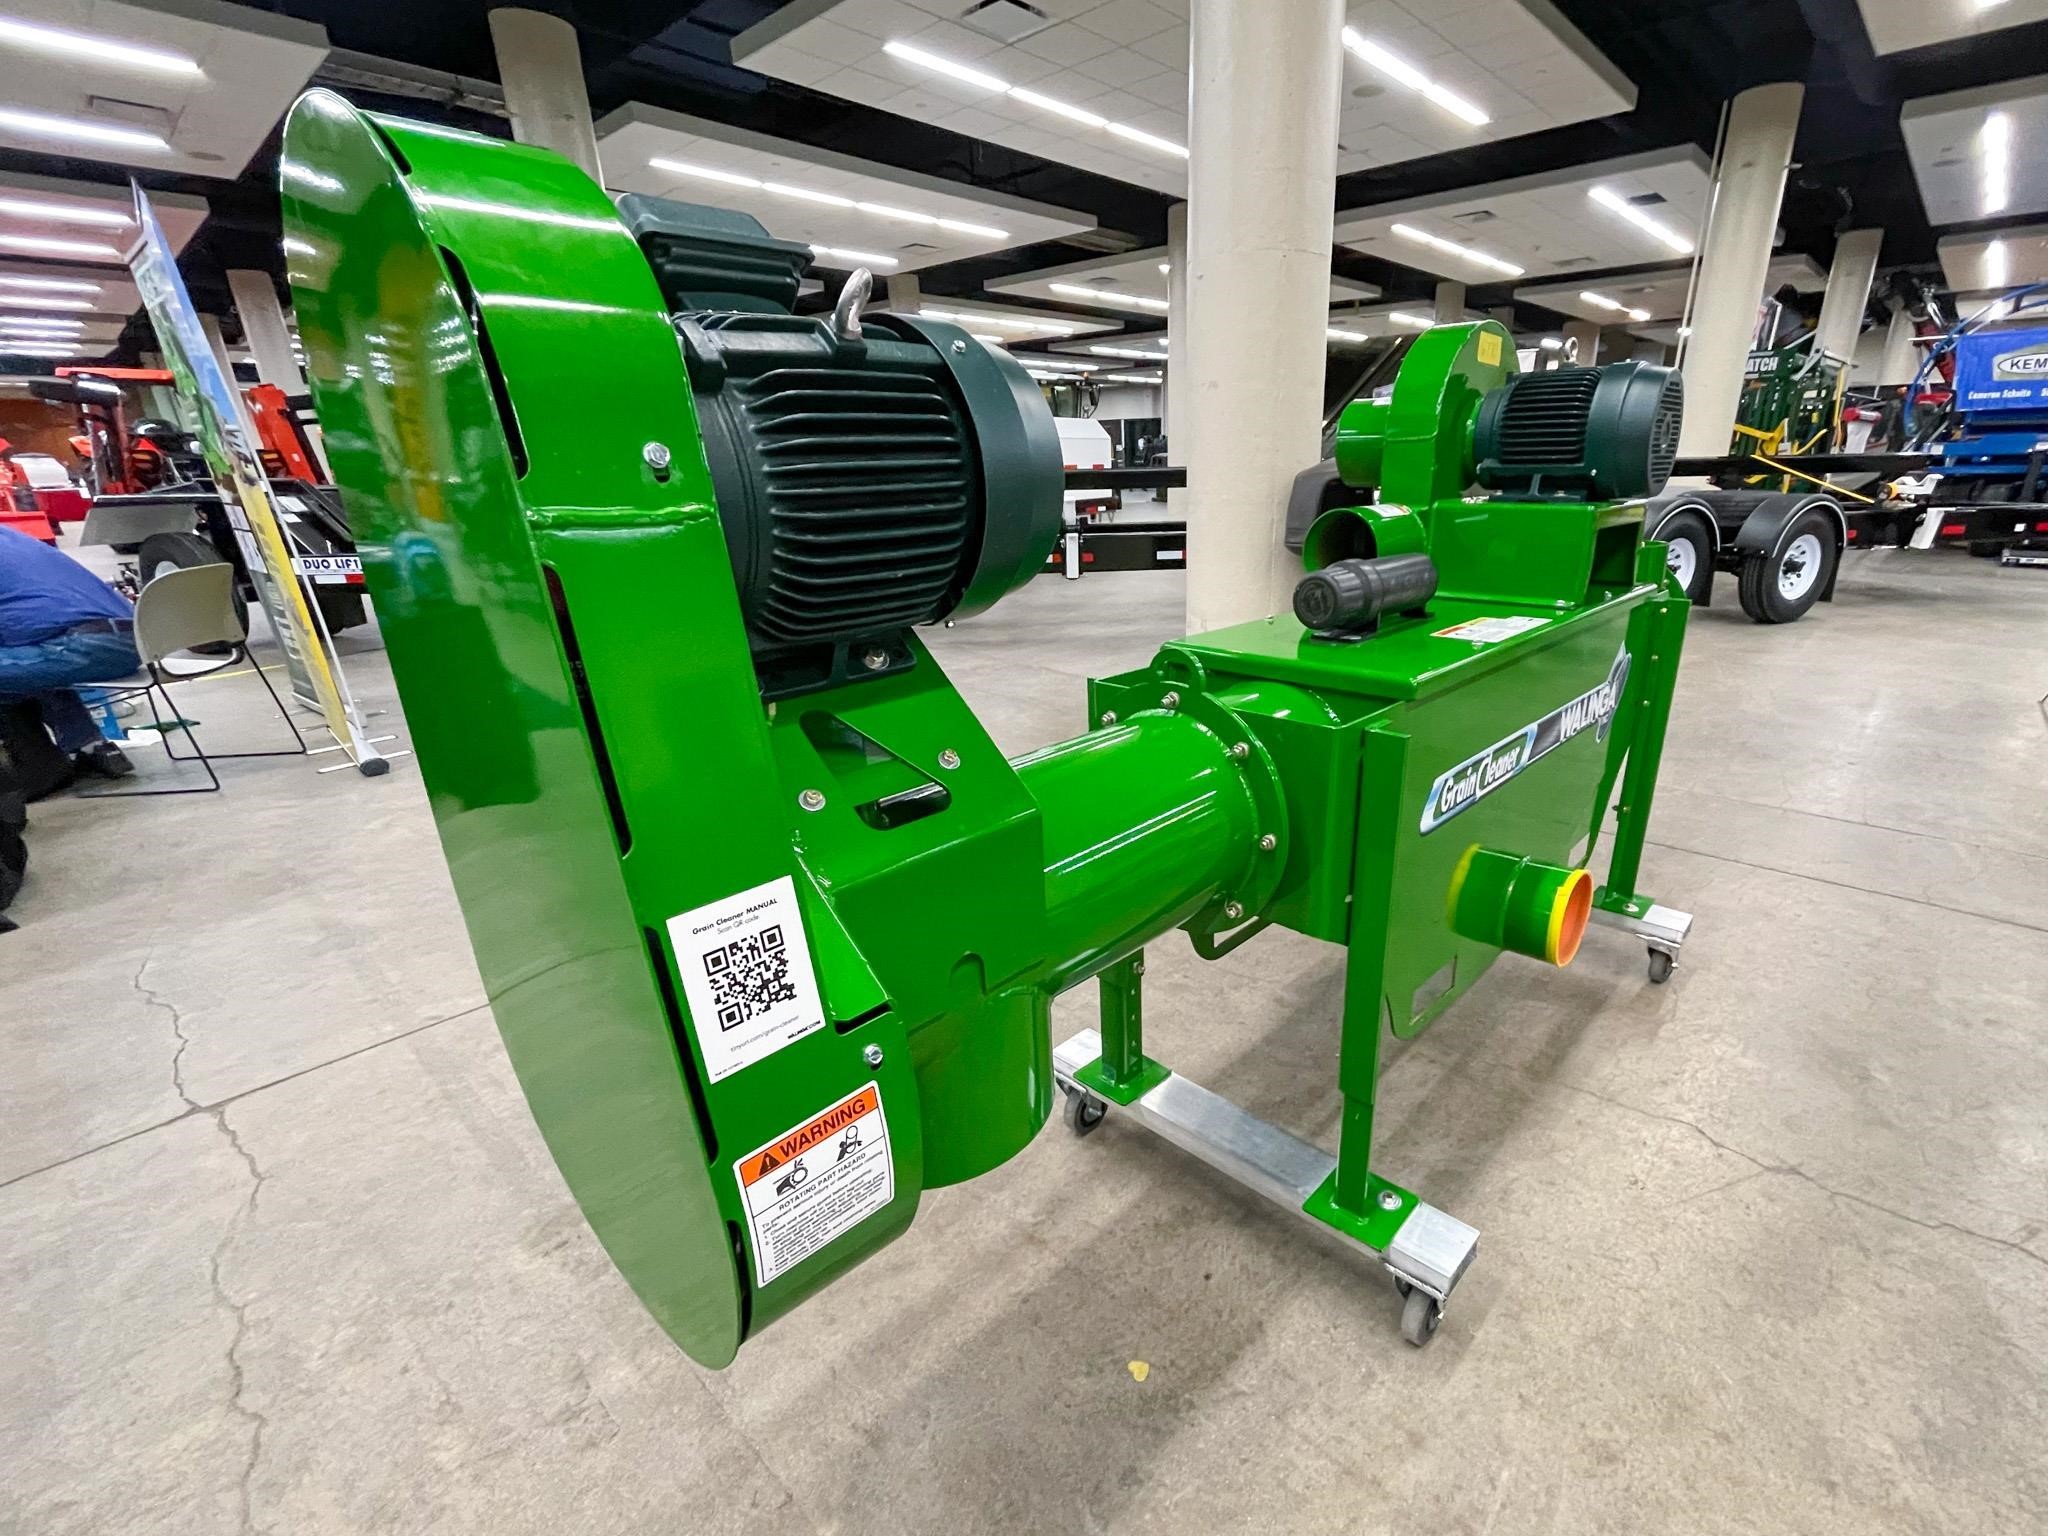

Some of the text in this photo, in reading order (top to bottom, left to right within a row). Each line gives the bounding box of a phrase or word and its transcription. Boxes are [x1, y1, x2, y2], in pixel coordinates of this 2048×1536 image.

[303, 558, 359, 570] DUO LIFT
[1560, 681, 1617, 741] WALINGA
[1441, 751, 1521, 813] Grain Cleaner
[692, 897, 778, 935] Grain Cleaner MANUAL
[780, 1098, 866, 1159] WARNING
[778, 1151, 865, 1211] ROTATING PART HAZARD
